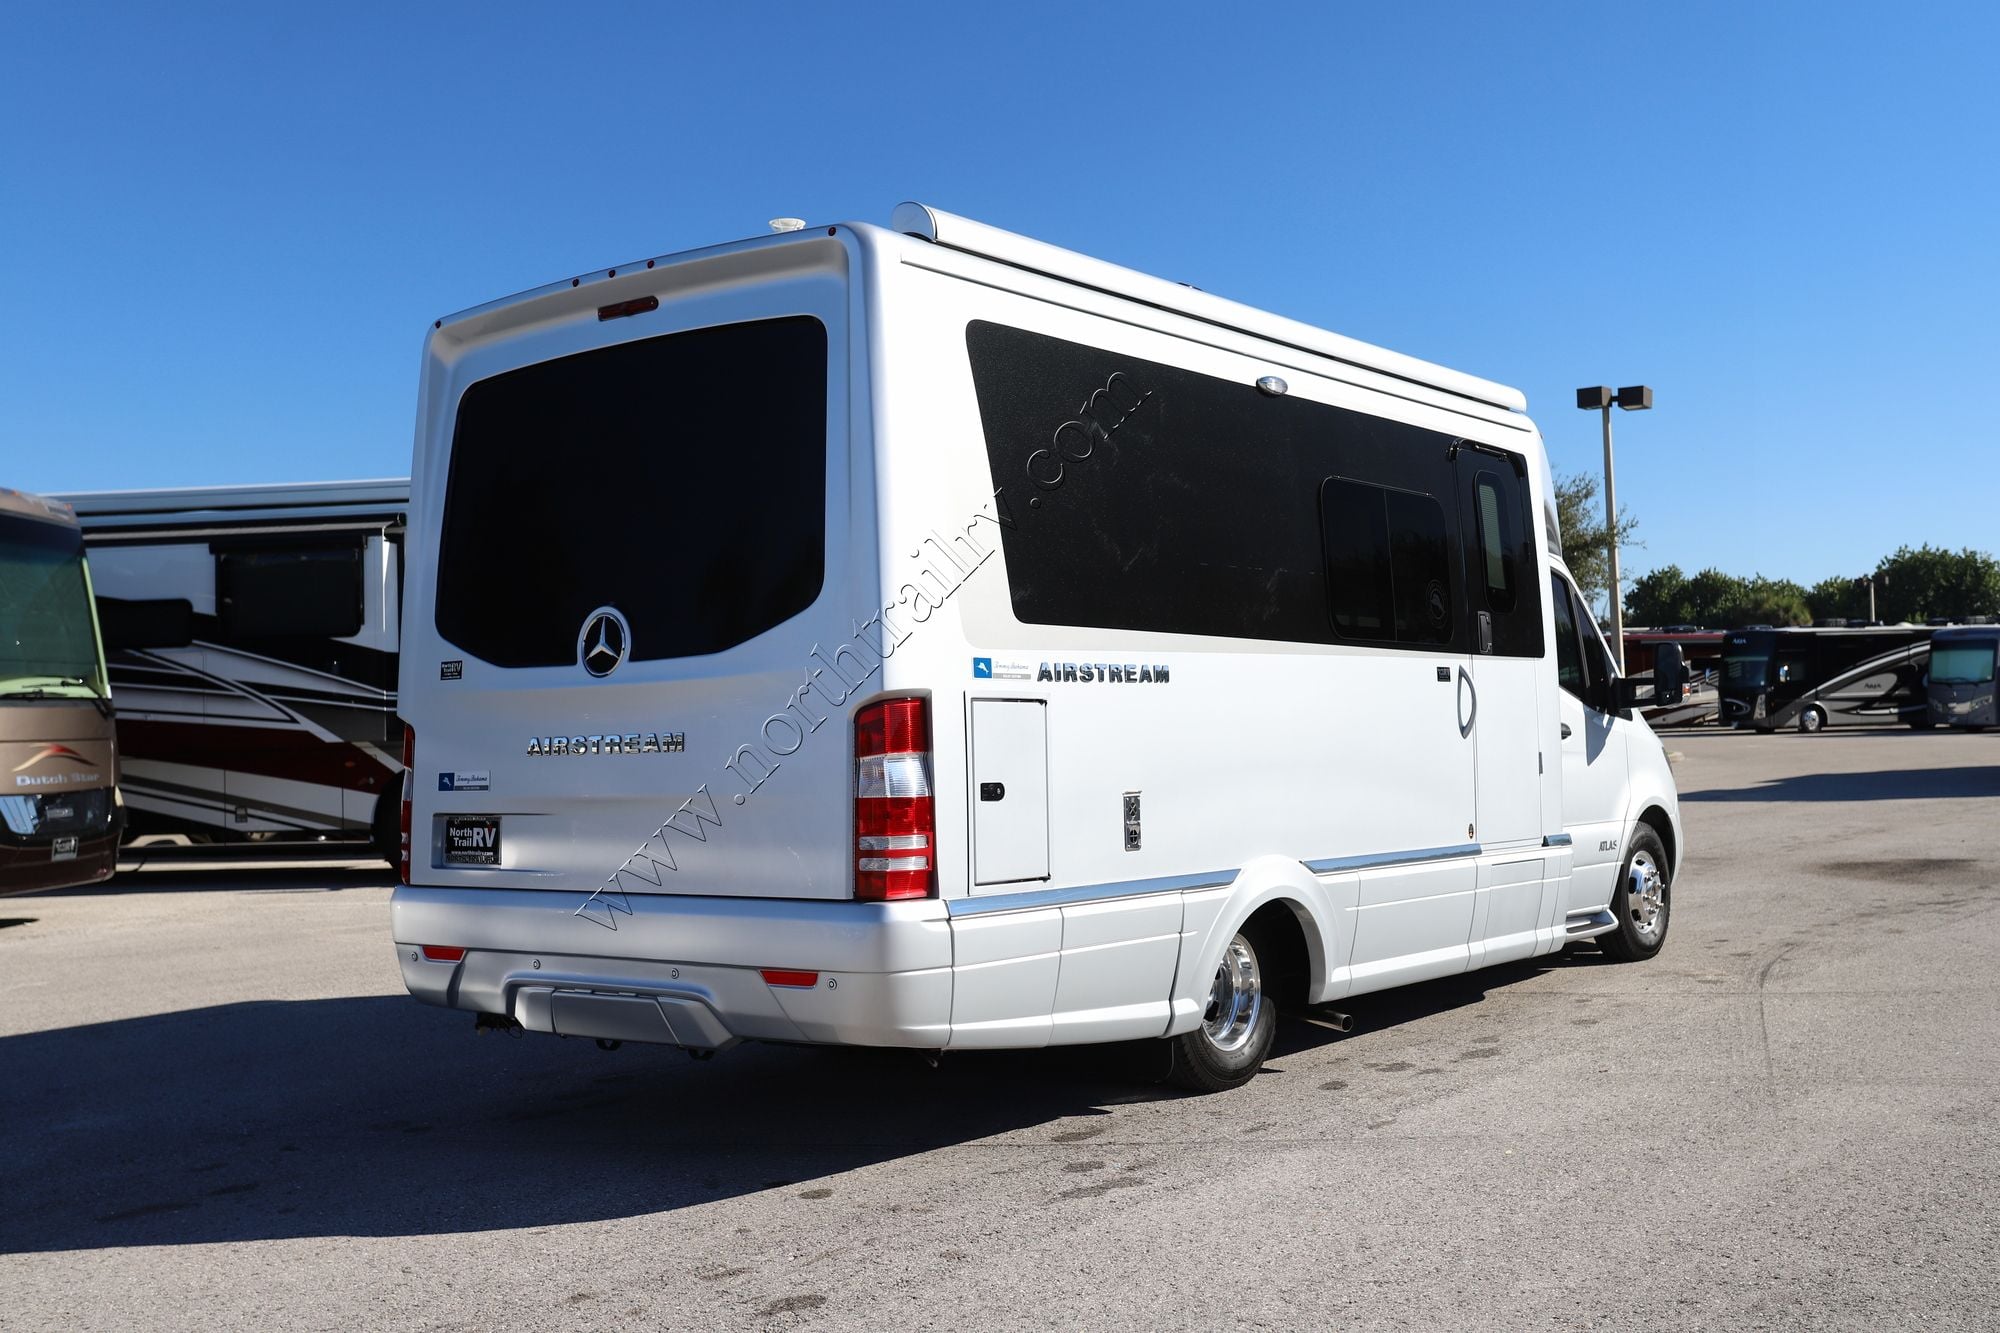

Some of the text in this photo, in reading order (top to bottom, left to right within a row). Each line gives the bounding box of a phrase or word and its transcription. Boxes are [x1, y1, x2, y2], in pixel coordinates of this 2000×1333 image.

[1036, 662, 1170, 683] AIRSTREAM
[527, 732, 685, 756] AIRSTREAM
[16, 772, 99, 787] Dutch Star
[450, 827, 472, 837] North
[472, 827, 497, 848] RV
[453, 837, 472, 847] Trail
[1599, 840, 1617, 851] ATLAS
